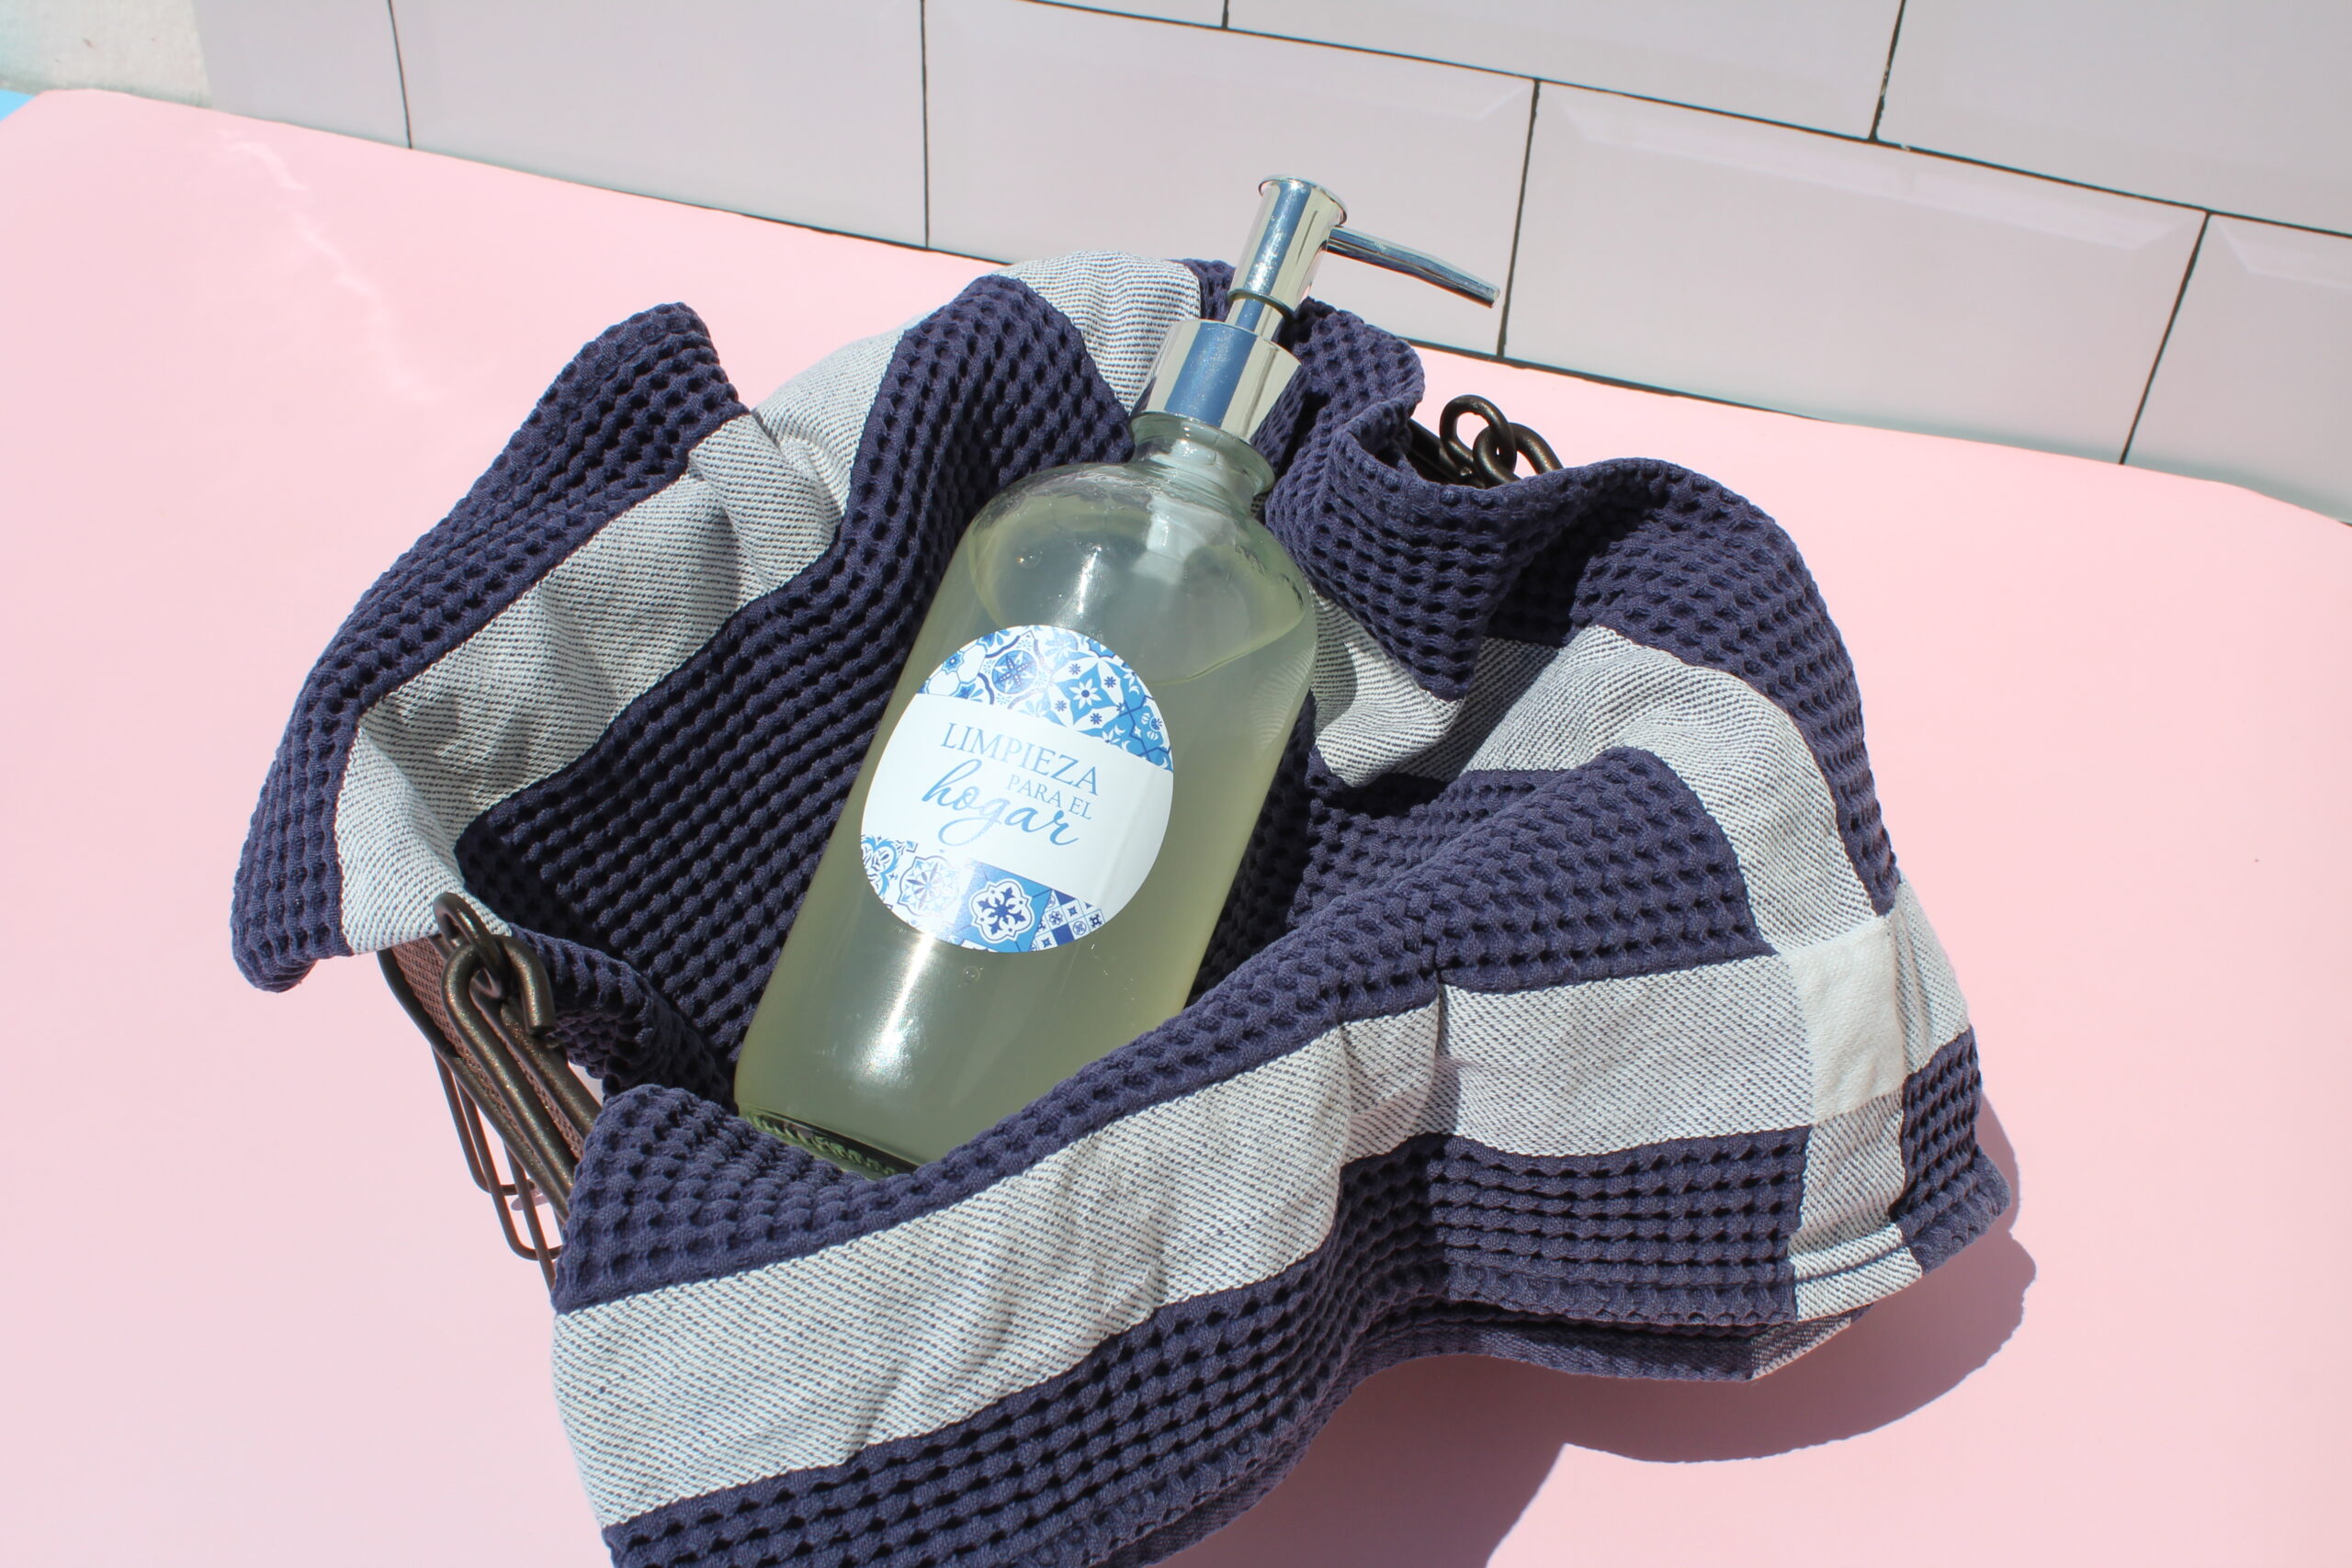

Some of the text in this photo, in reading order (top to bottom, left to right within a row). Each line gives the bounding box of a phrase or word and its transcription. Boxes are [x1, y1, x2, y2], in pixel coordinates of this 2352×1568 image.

[941, 722, 1099, 796] LIMPIEZA
[922, 759, 1080, 846] hogar
[1006, 774, 1093, 820] PARA EL
